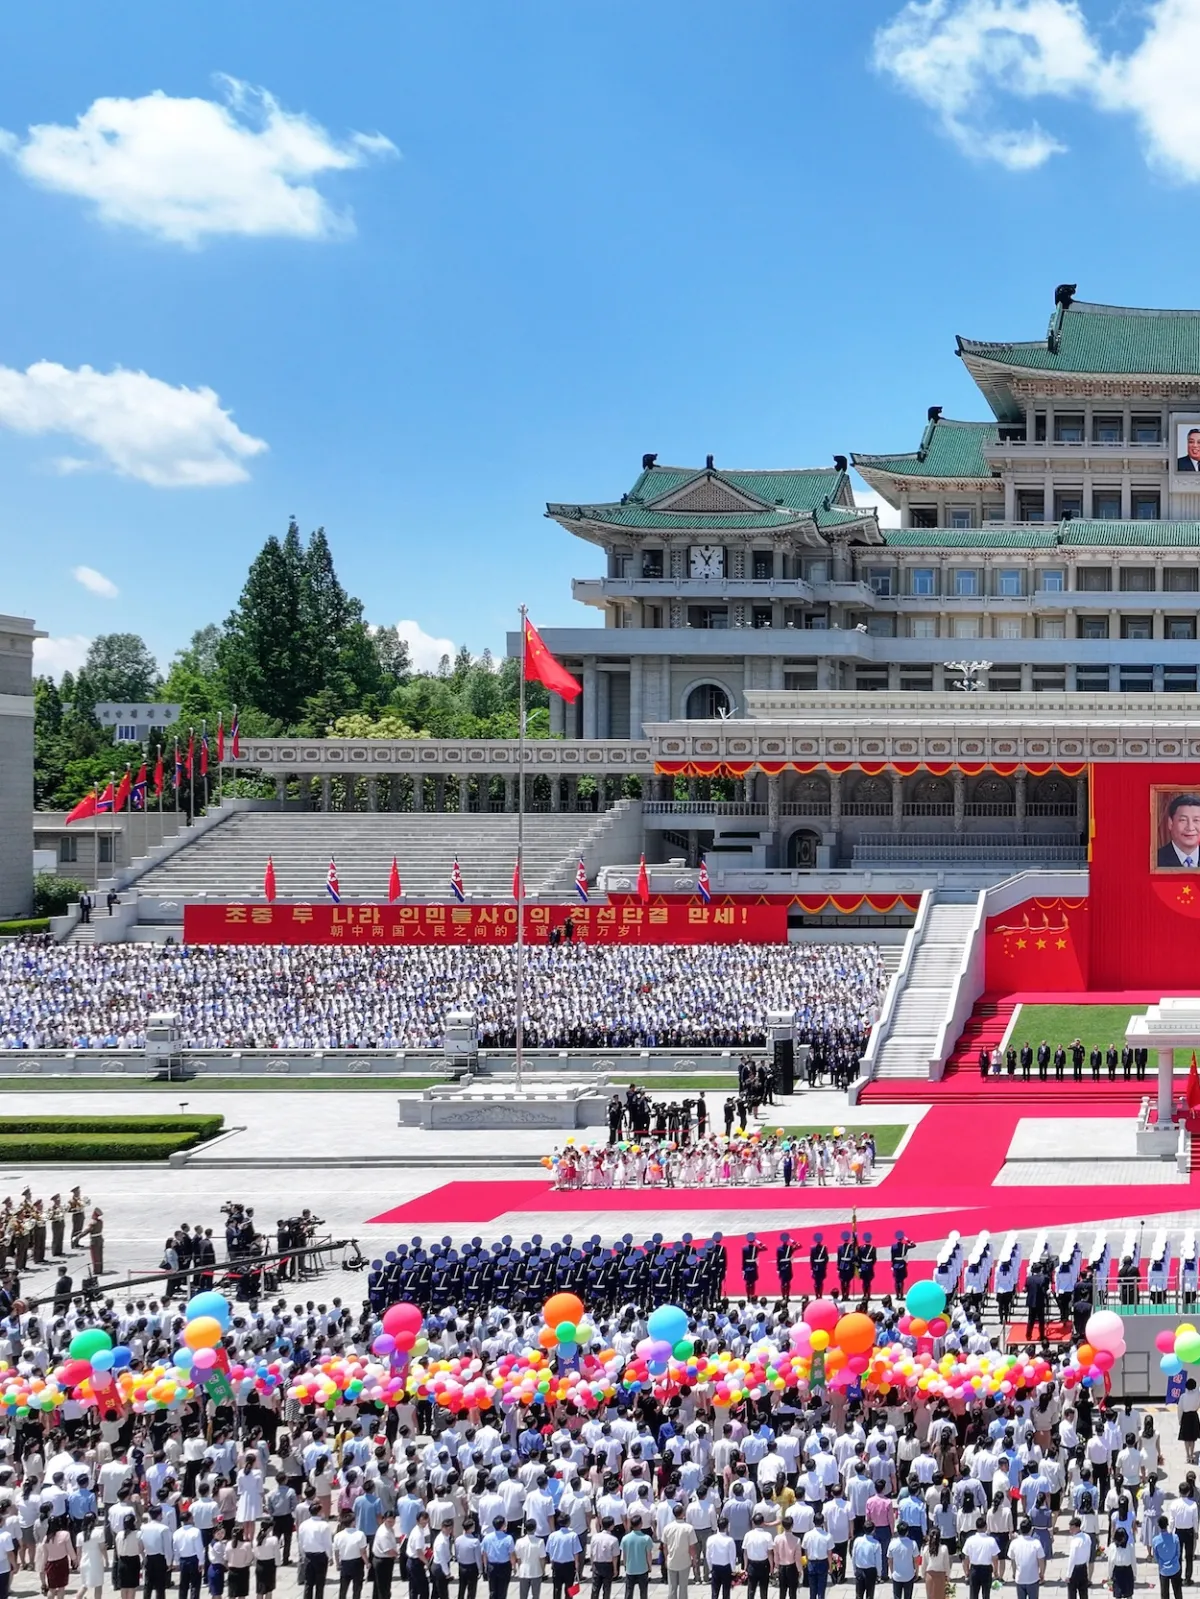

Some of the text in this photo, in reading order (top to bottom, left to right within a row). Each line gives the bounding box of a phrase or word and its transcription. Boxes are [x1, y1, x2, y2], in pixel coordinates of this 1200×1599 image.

[225, 907, 273, 924] 조중
[292, 907, 314, 924] 두
[332, 907, 381, 924] 나라
[567, 907, 669, 924] 친선단결
[688, 907, 748, 925] 만세!
